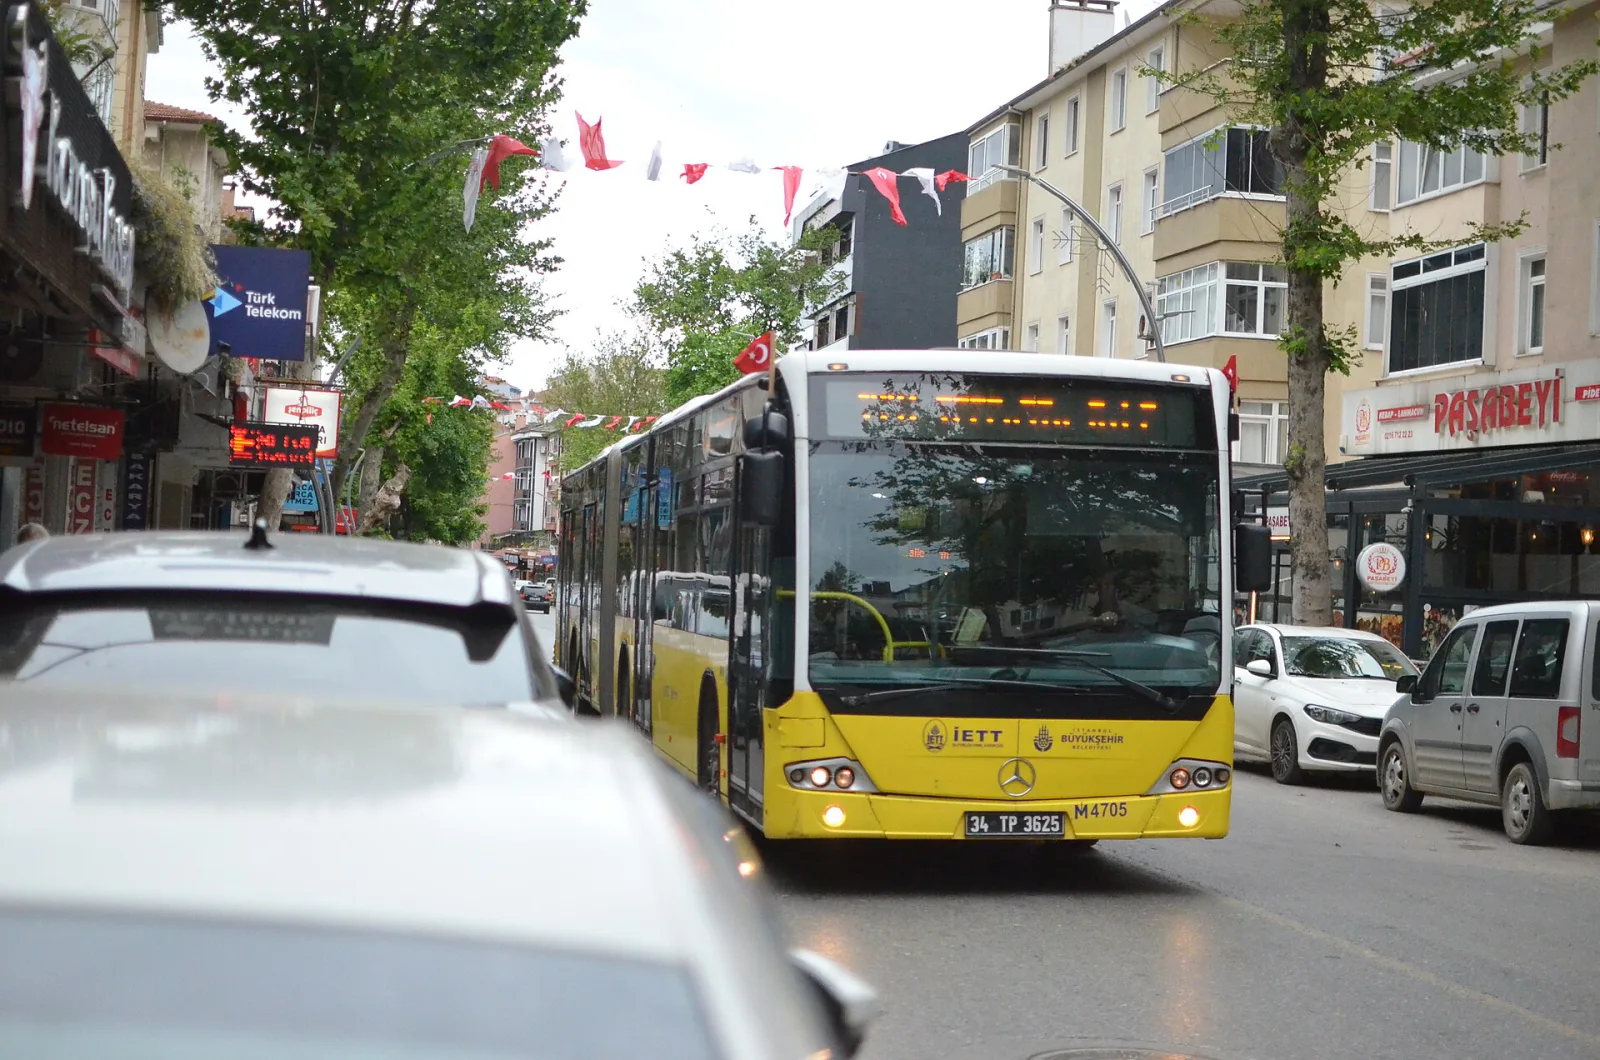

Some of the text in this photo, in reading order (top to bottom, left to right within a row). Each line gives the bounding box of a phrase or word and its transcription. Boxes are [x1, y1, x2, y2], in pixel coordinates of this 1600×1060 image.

[245, 291, 276, 305] Türk
[245, 305, 302, 320] Telekom
[1434, 368, 1561, 441] PAŞABEYİ
[52, 419, 116, 435] netelsan
[1266, 515, 1290, 530] AŞABE
[953, 726, 1003, 742] İETT
[1060, 732, 1124, 746] BÜYÜKŞEHİR
[970, 815, 1060, 833] 34 TP 3625
